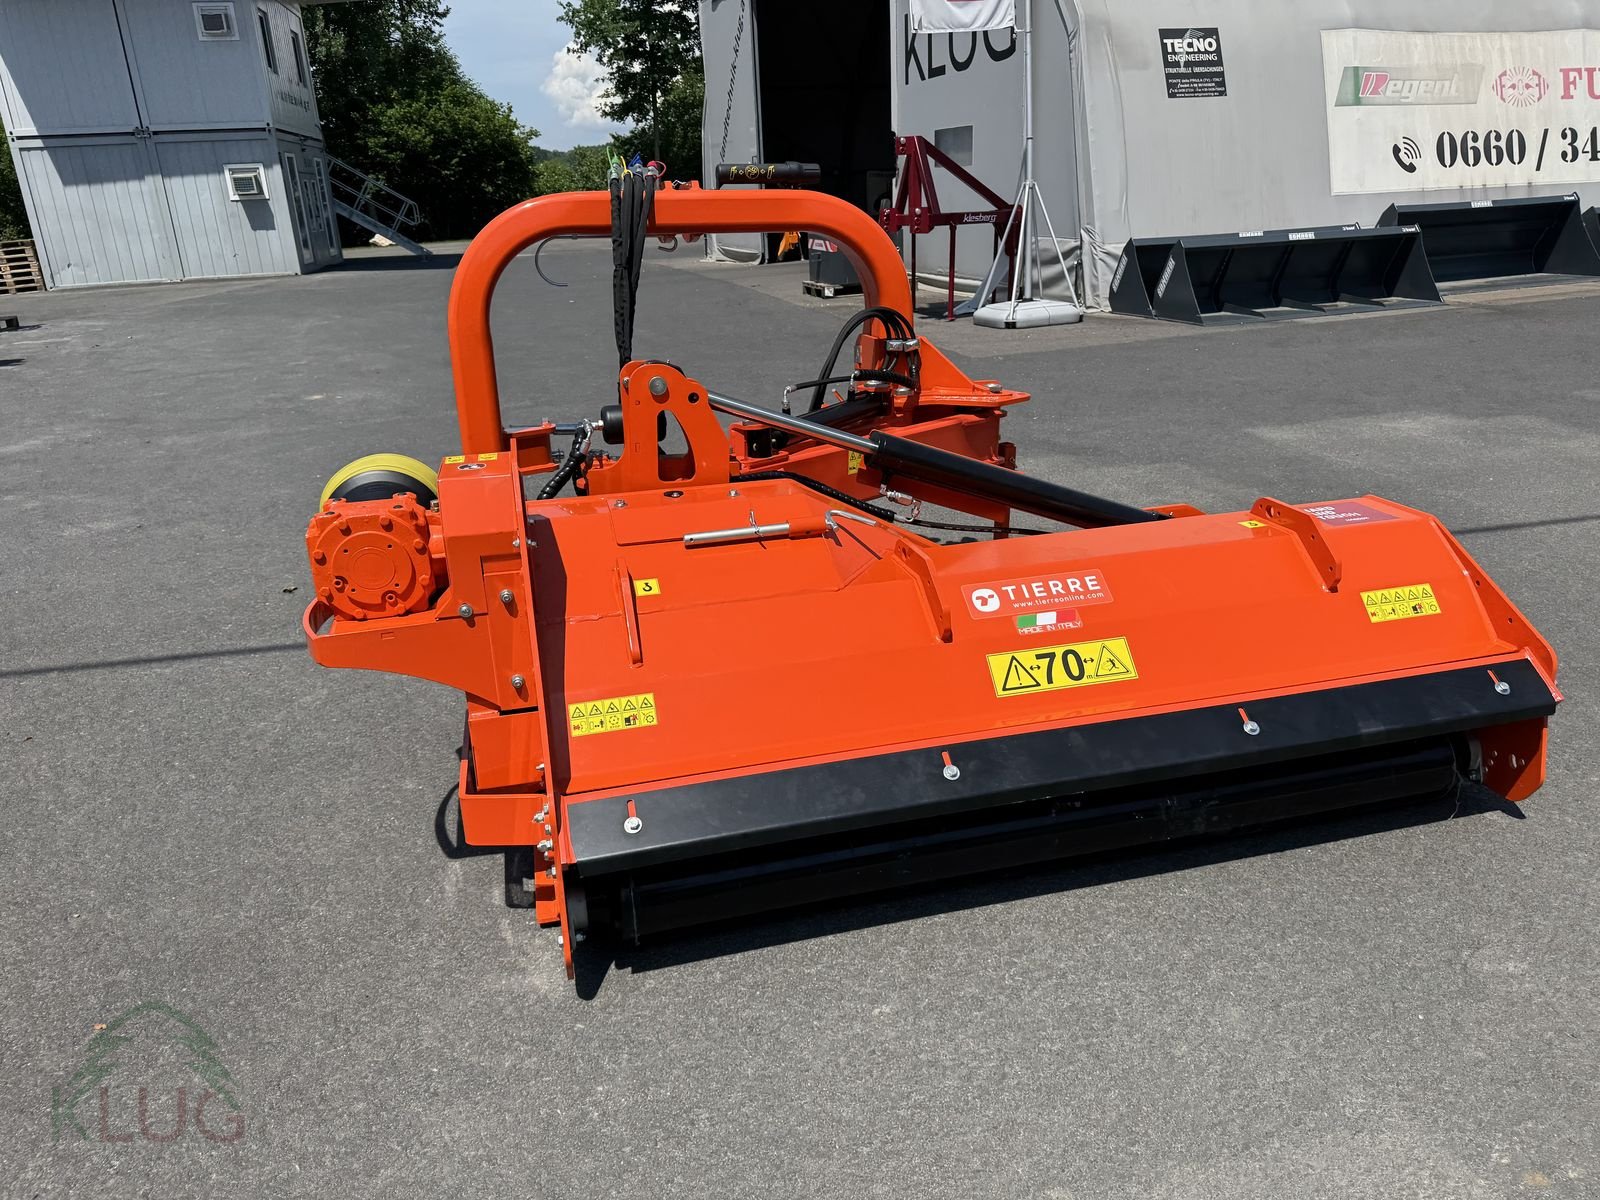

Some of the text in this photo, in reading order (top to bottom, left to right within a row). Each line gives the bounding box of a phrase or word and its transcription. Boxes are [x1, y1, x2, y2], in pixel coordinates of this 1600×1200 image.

[1163, 37, 1217, 53] TECNO
[1167, 53, 1218, 62] ENGINEERING
[1359, 72, 1460, 104] Regent
[1436, 126, 1600, 172] 0660 / 34
[1001, 576, 1102, 601] TIERRE
[1012, 591, 1105, 609] www.tierreonline.com
[1018, 620, 1082, 635] MADE IN ITALY
[1035, 648, 1086, 685] 70
